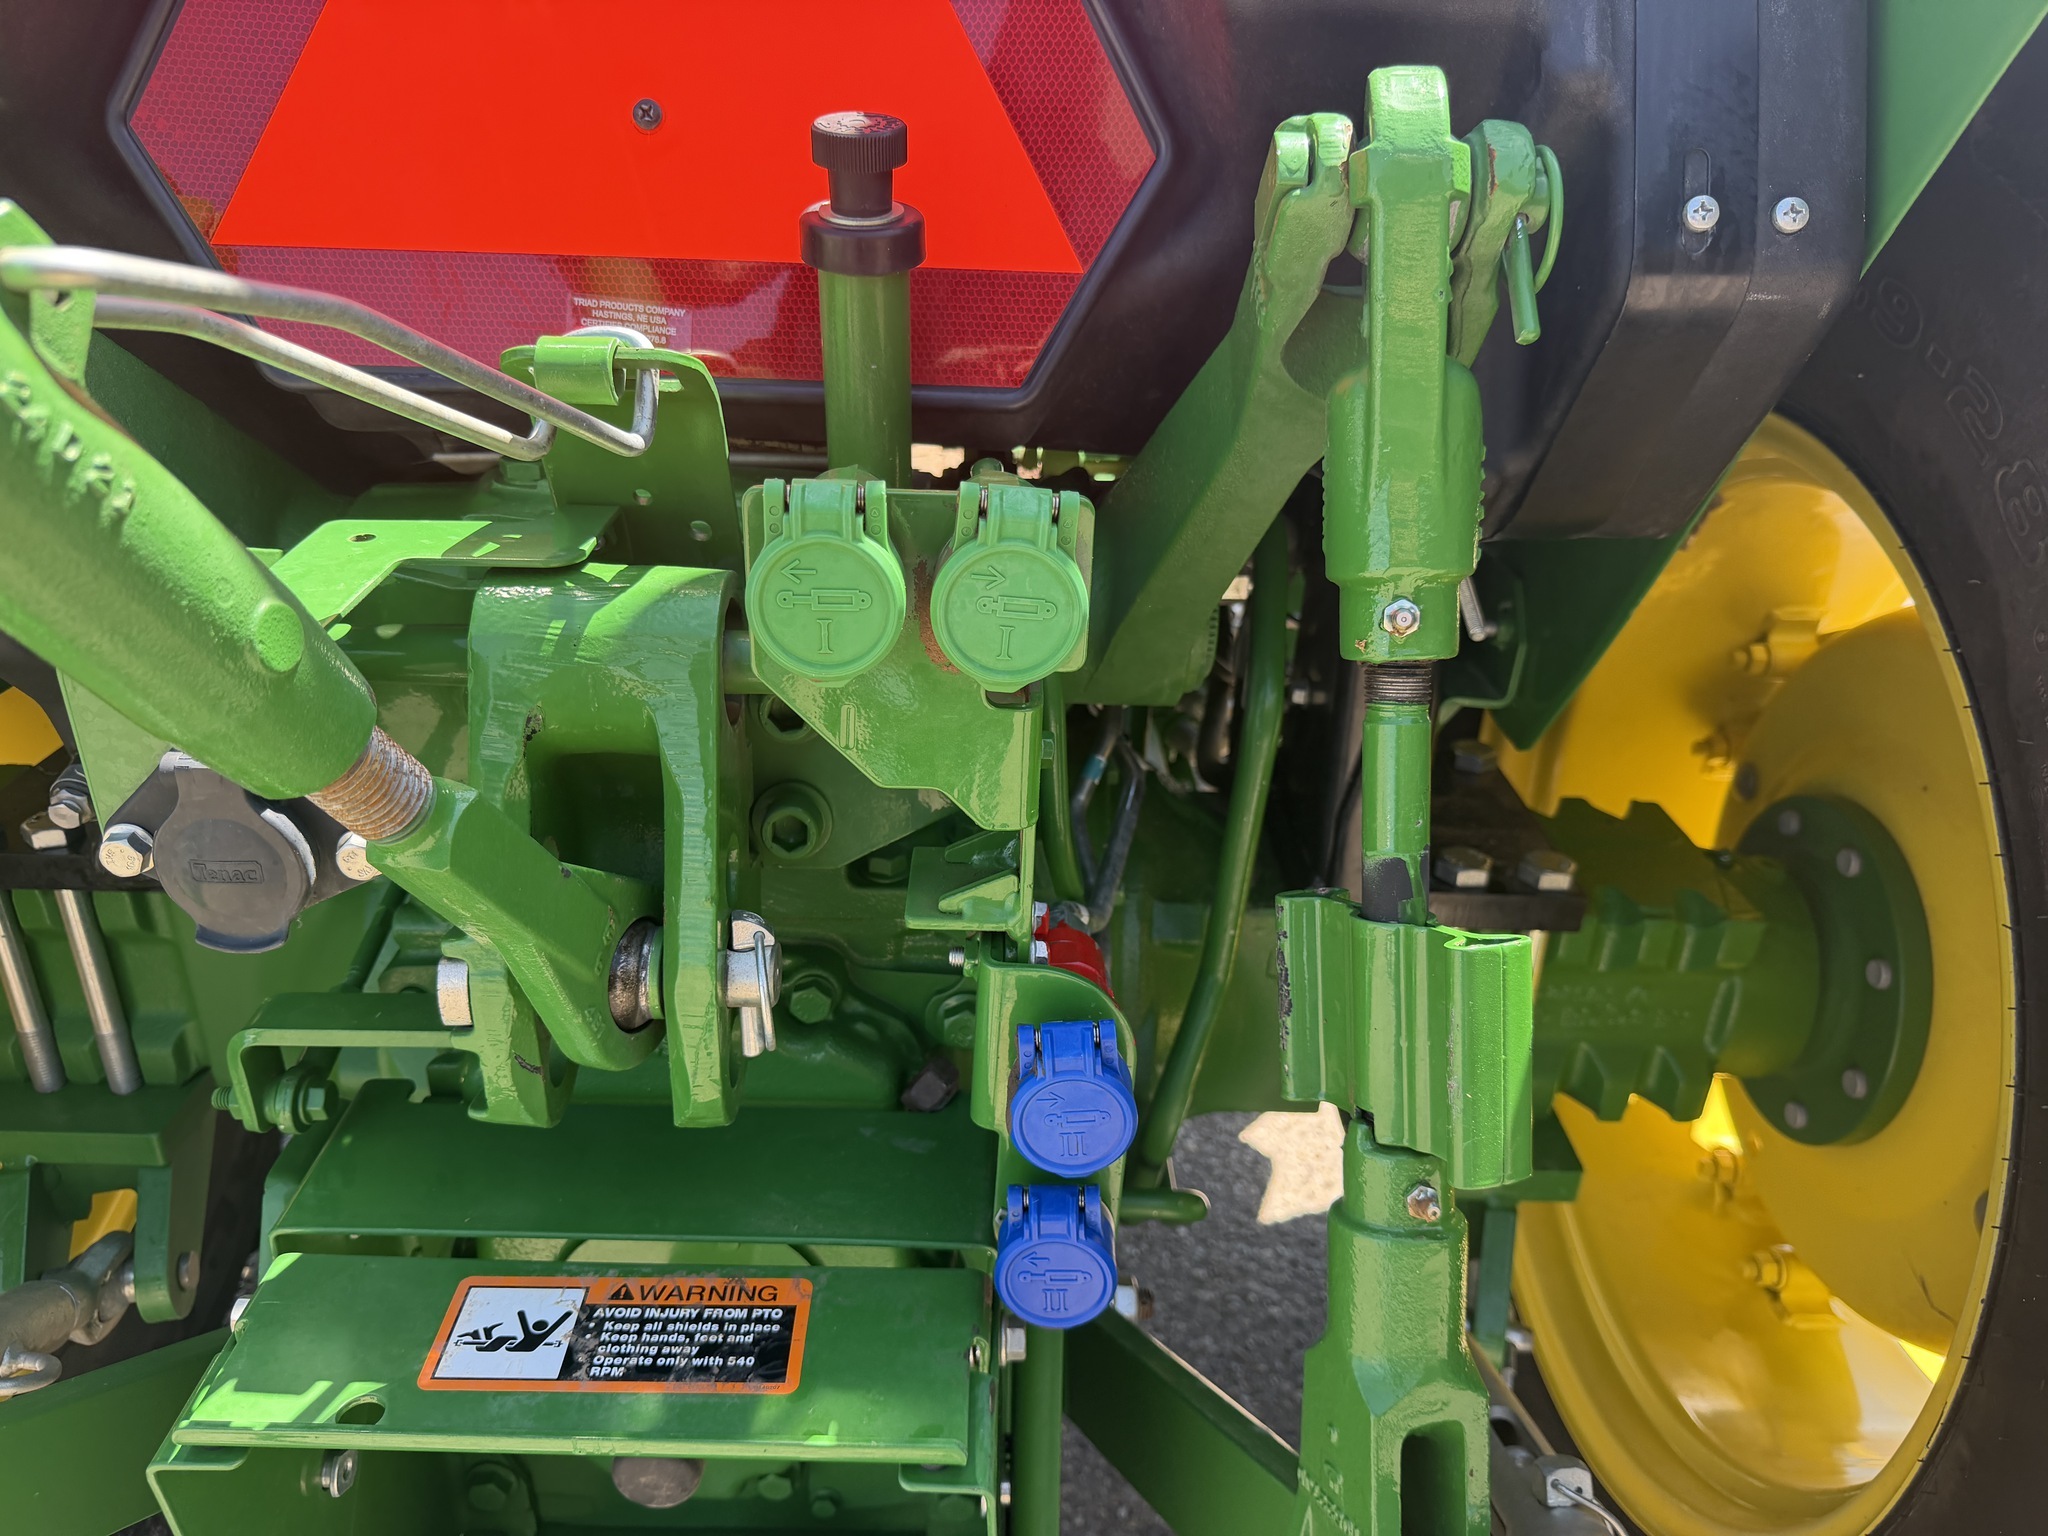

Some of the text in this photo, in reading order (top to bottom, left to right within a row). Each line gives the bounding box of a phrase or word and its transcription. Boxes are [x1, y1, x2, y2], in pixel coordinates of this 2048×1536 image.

[573, 297, 686, 317] TRIAD PRODUCTS COMPANY
[592, 309, 667, 325] HASTINGS, NE USA
[624, 322, 677, 336] COMPLIANCE
[639, 1284, 778, 1302] WARNING
[593, 1307, 784, 1320] AVOID INJURY FROM PTO
[603, 1321, 781, 1334] Keep all shields in place
[600, 1332, 754, 1343] Keep hands, feet and
[597, 1344, 700, 1356] clothing away
[592, 1355, 755, 1367] Operate only with 540
[589, 1366, 625, 1377] RPM
